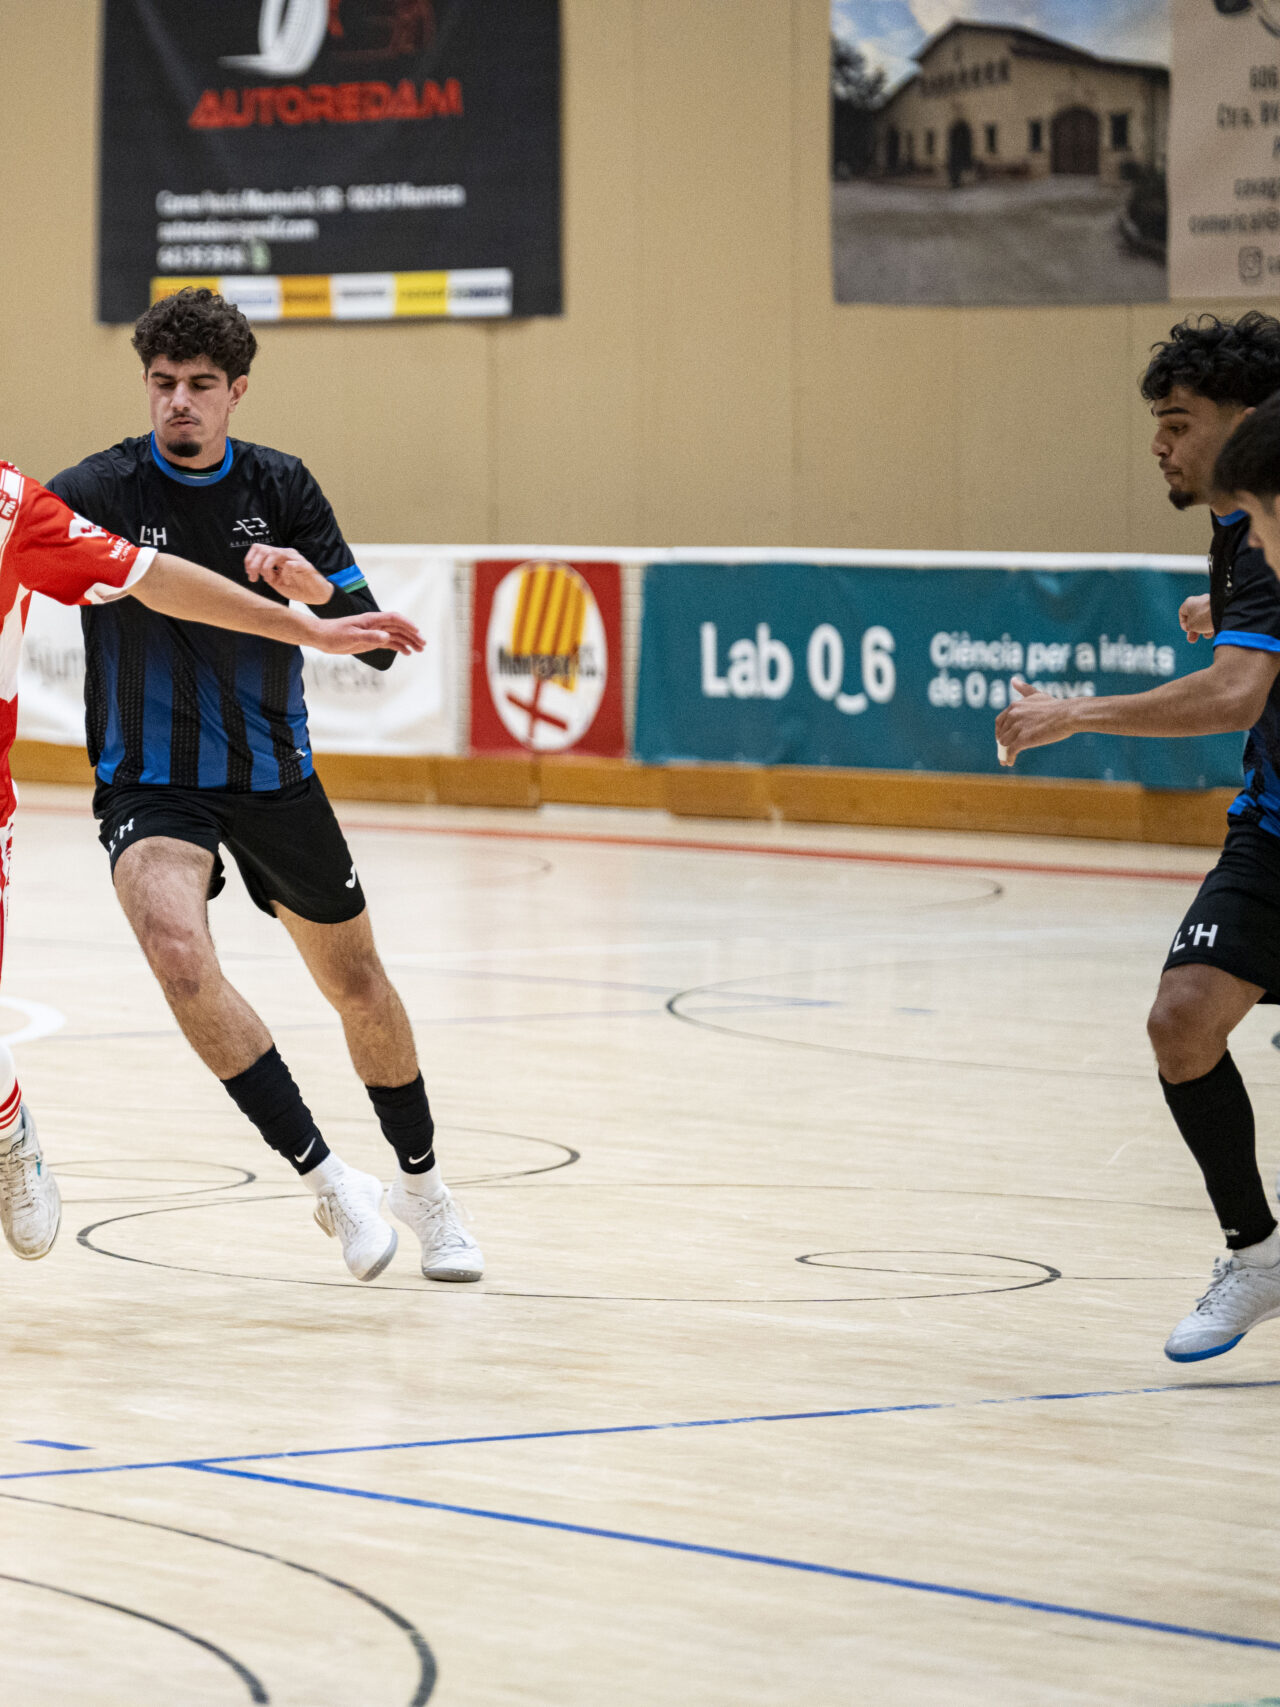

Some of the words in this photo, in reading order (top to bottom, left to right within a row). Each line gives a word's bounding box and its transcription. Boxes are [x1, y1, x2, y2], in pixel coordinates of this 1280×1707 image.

[189, 79, 462, 128] AUTOREDAM
[140, 525, 168, 546] L'H
[700, 621, 793, 699] Lab
[1026, 642, 1071, 677] per
[1075, 642, 1096, 672] a
[928, 669, 963, 708] de
[989, 679, 1007, 709] a
[1172, 923, 1218, 952] L'H
